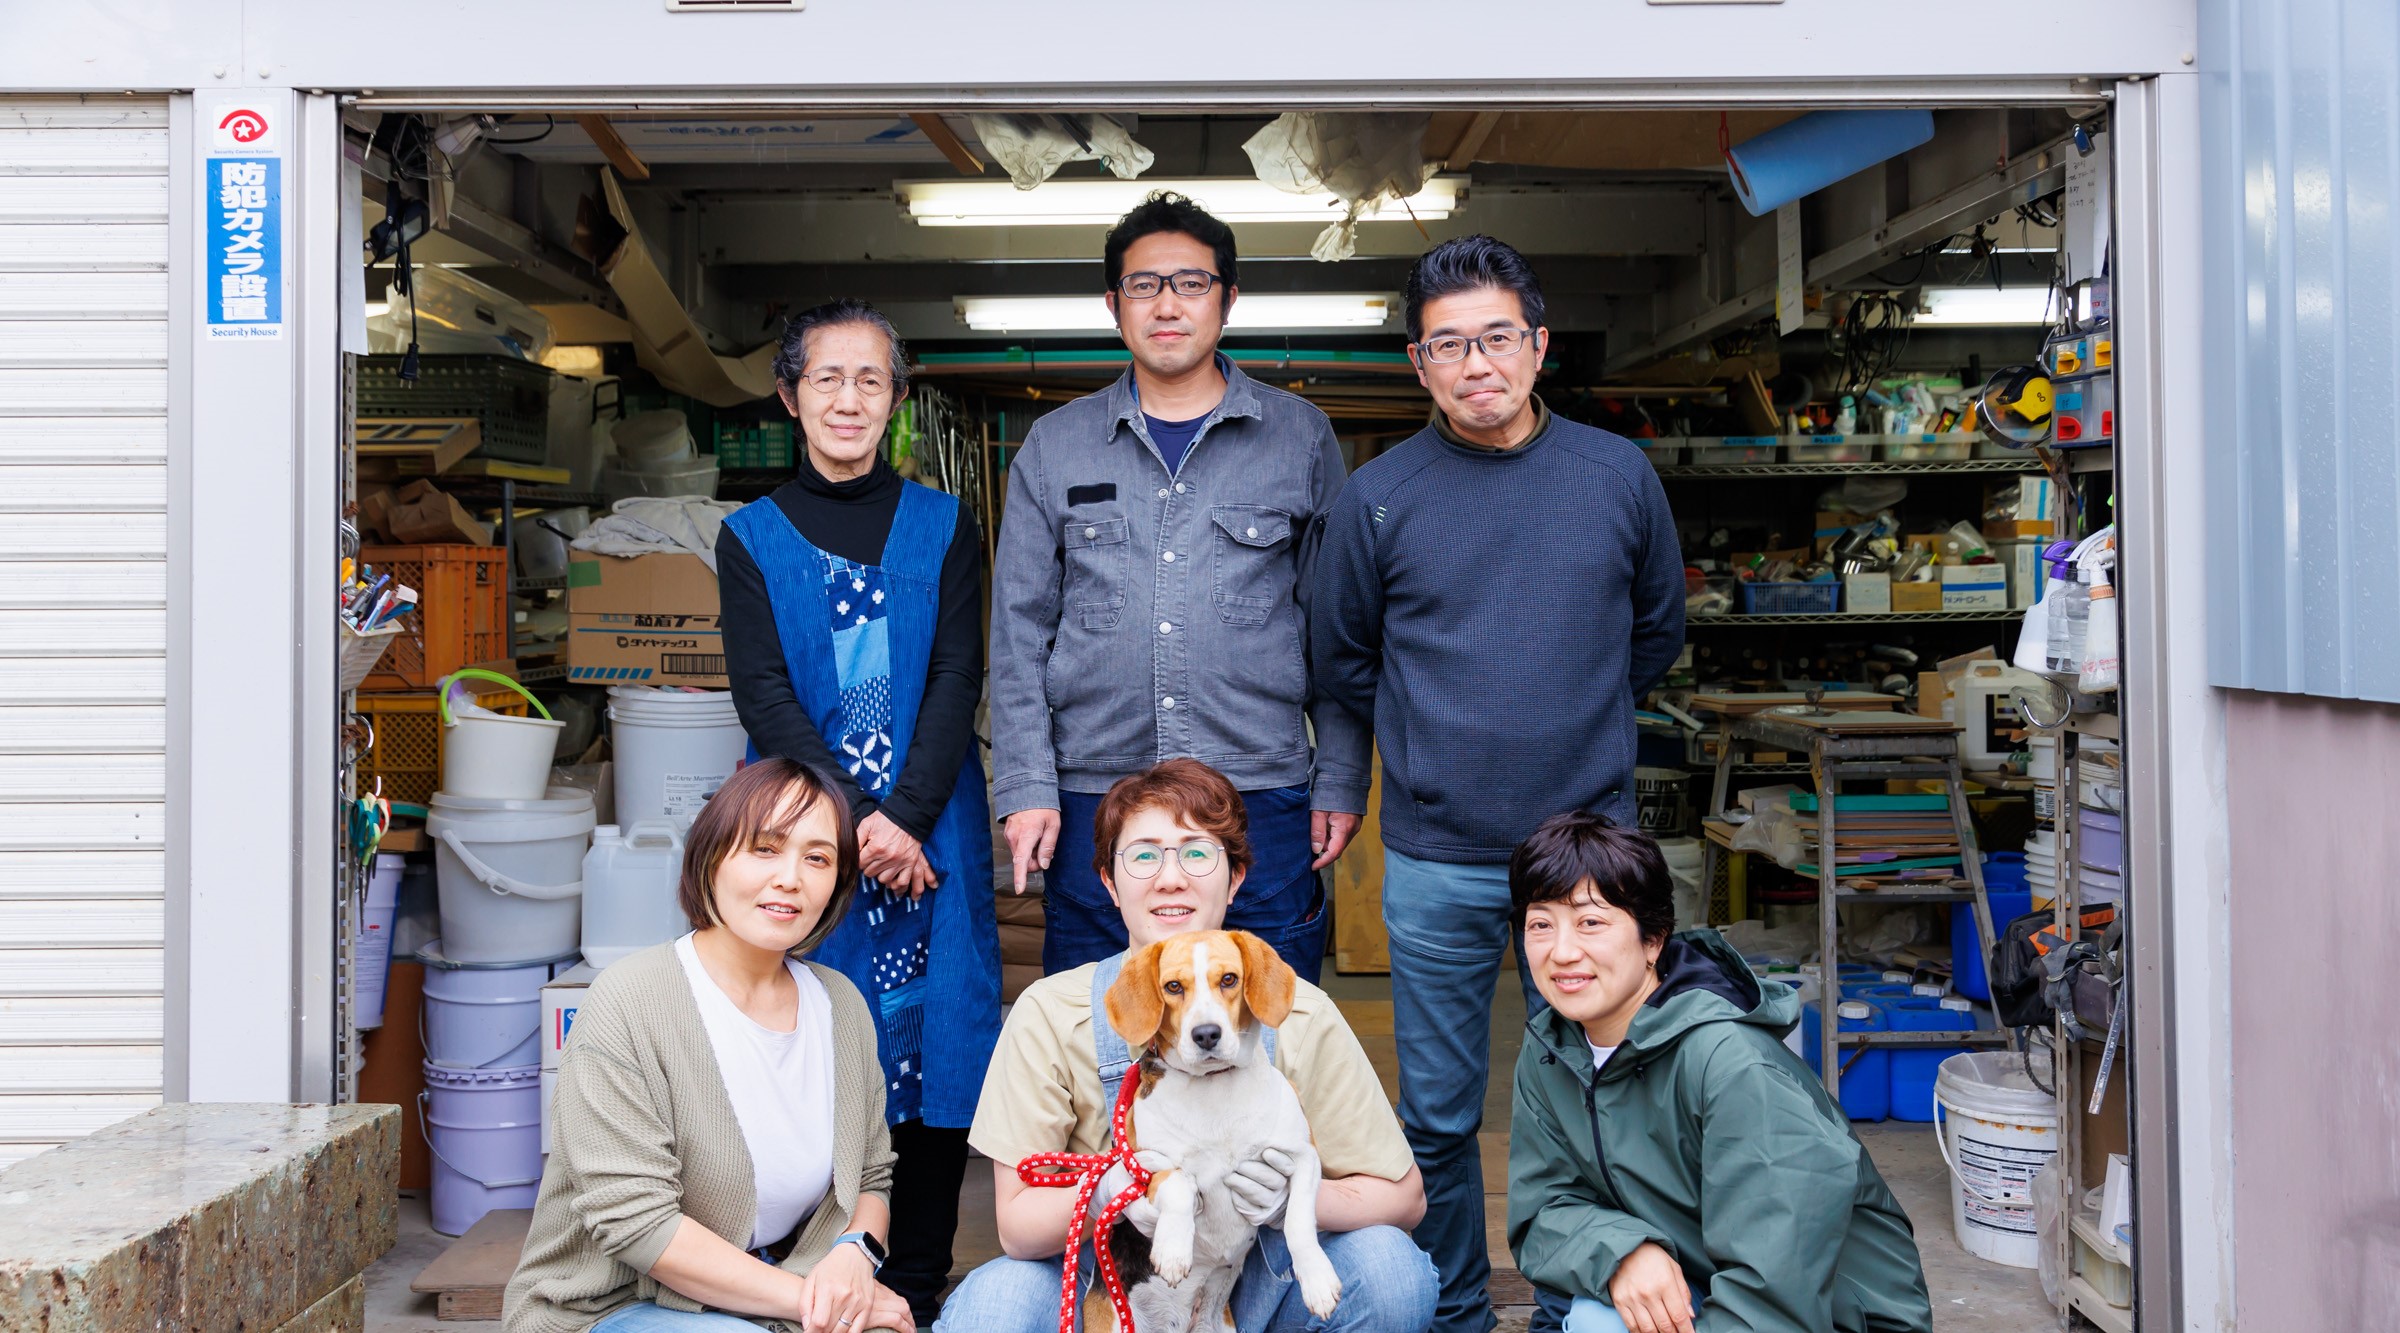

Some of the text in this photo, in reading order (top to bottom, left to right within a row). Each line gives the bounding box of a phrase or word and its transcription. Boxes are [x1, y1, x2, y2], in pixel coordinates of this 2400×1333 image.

[220, 162, 268, 321] 防犯カメラ設置
[212, 327, 278, 338] Security House
[634, 614, 720, 628] 粘着テー
[630, 638, 698, 648] ダイヤテックス
